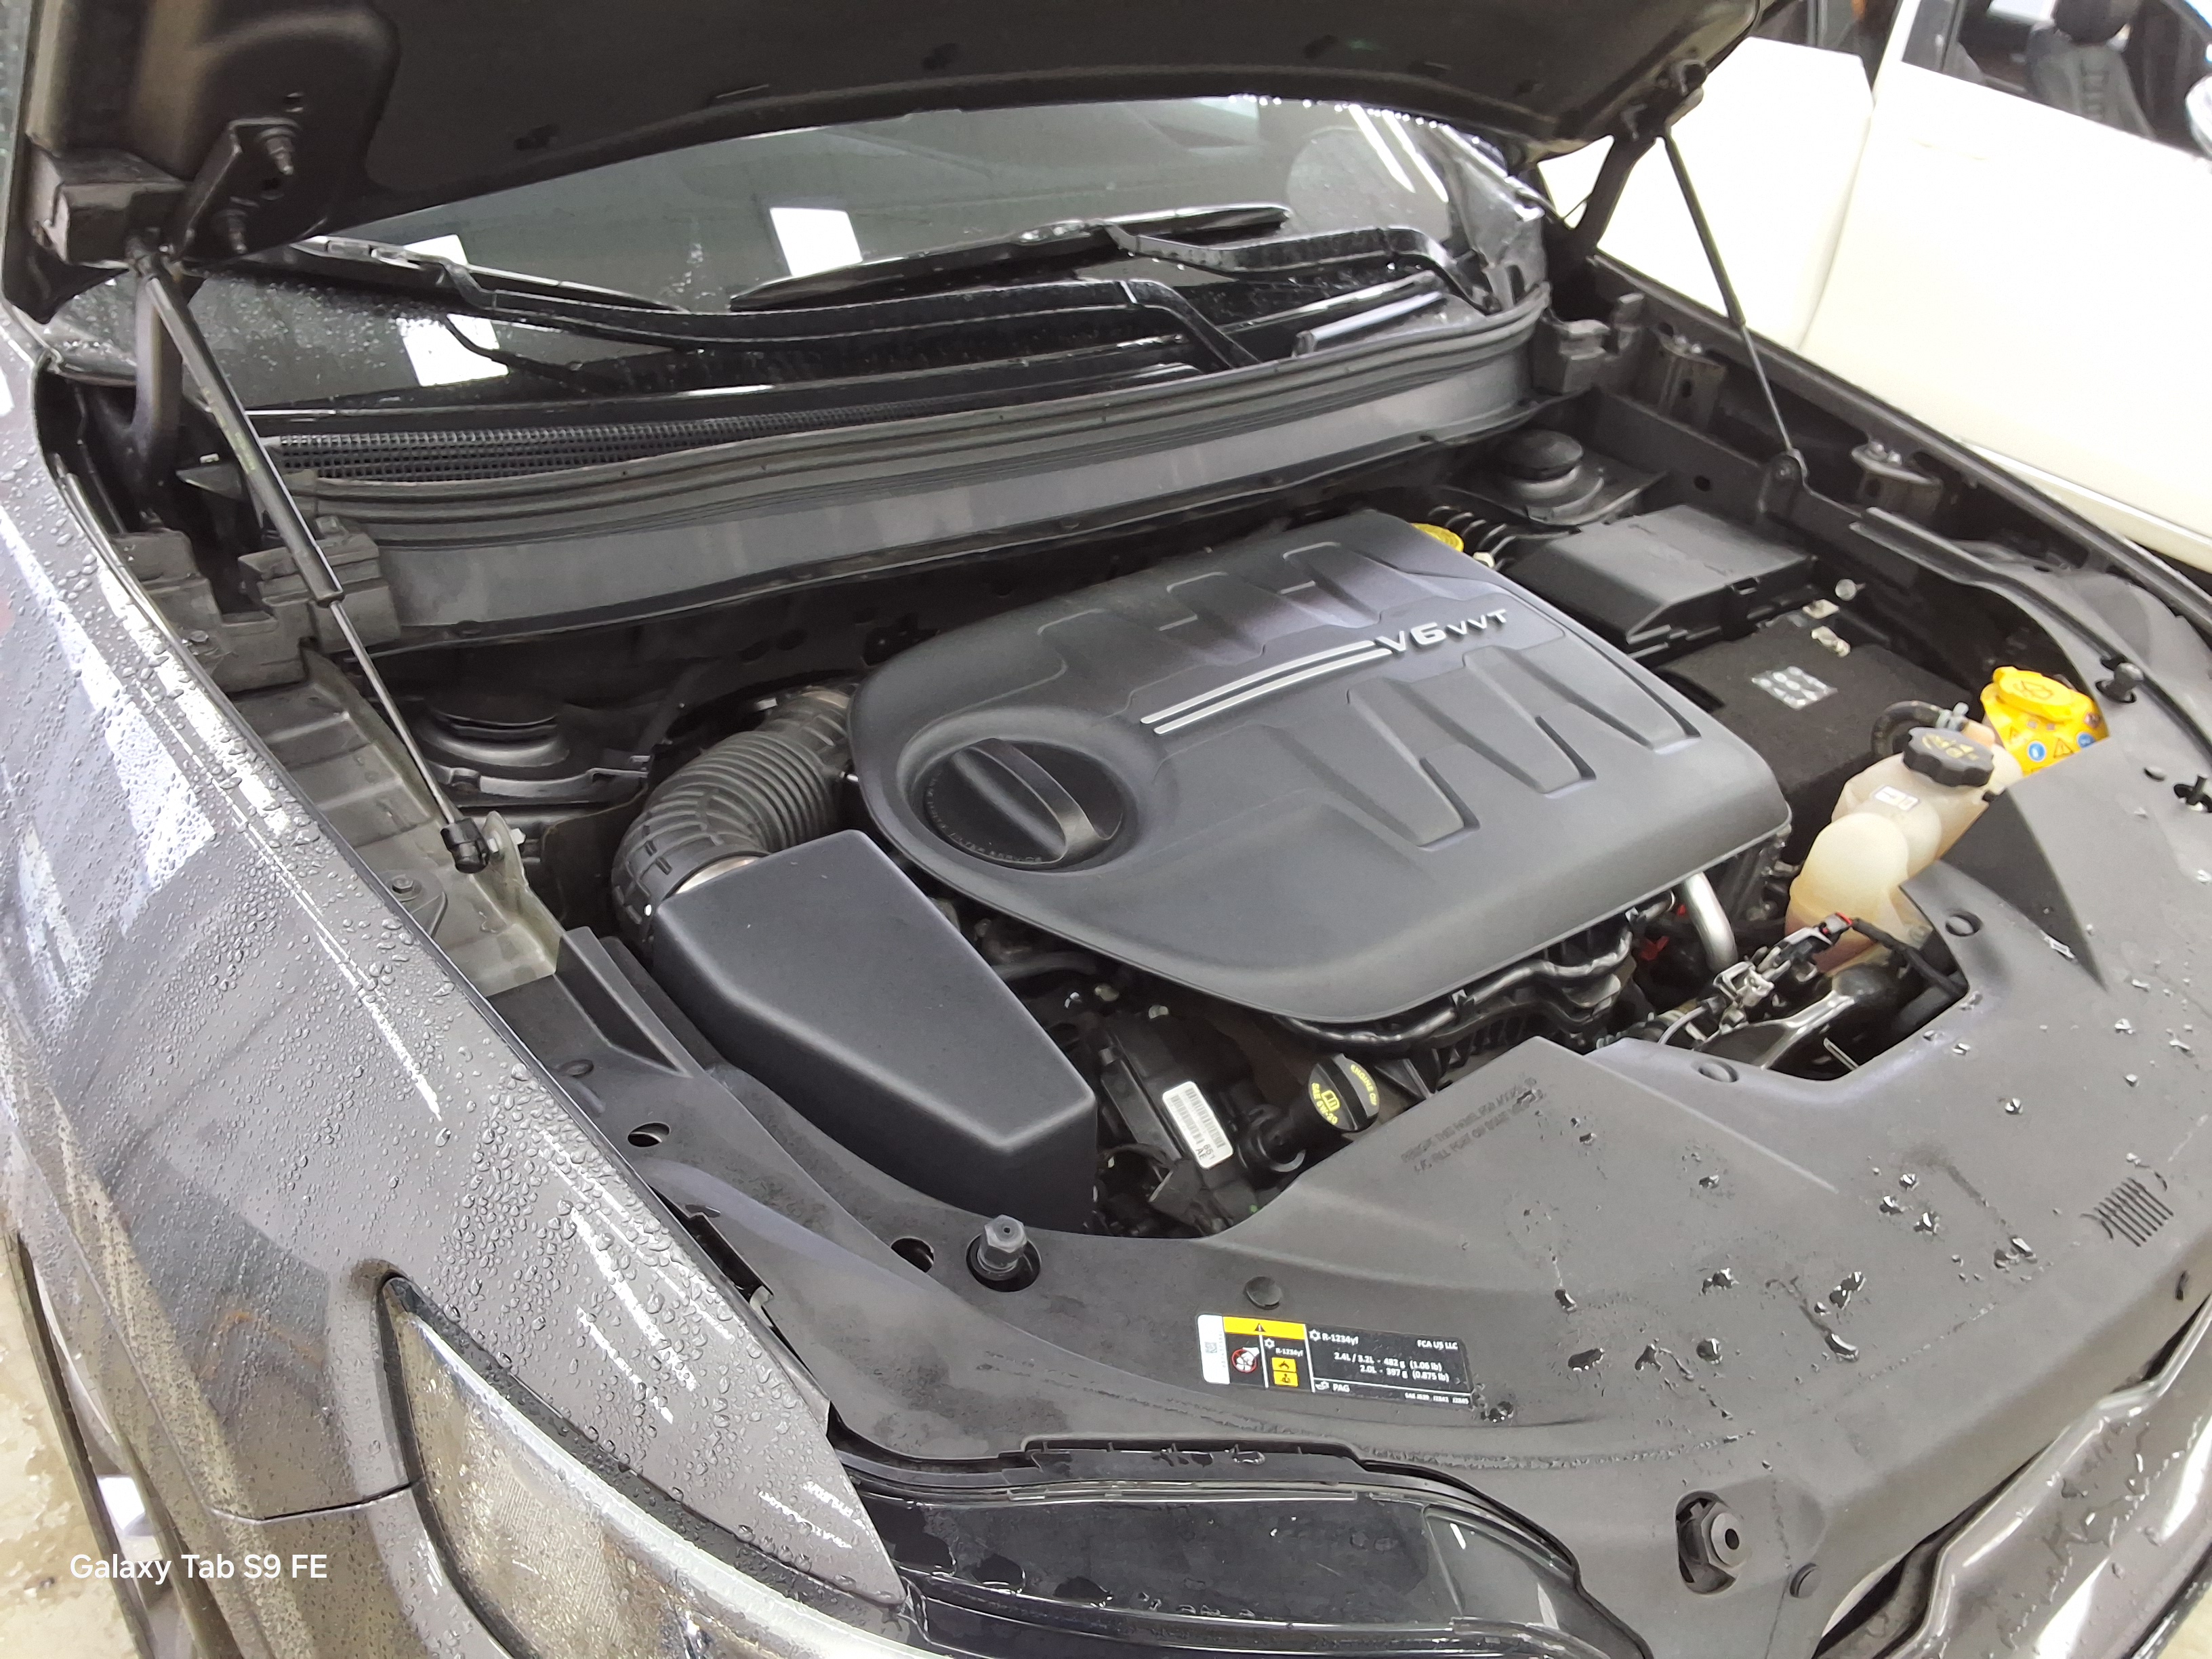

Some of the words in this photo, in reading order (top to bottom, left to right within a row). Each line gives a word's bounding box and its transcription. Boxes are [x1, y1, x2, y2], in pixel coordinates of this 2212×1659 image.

[1374, 622, 1446, 651] V6
[1446, 609, 1507, 635] VVT
[1312, 1082, 1322, 1100] SAE
[1316, 1100, 1338, 1124] 5W-20
[1322, 1332, 1359, 1346] R-1234yf
[1417, 1339, 1432, 1348] FCA
[1433, 1340, 1444, 1349] US
[1445, 1342, 1458, 1350] LLC
[1275, 1347, 1303, 1357] R-1234yf
[1334, 1352, 1351, 1361] 2.4L
[1357, 1354, 1374, 1364] 3.2L
[1431, 1361, 1442, 1372] lb)
[1359, 1364, 1377, 1374] 2.0L
[1386, 1368, 1400, 1376] 397
[1437, 1372, 1450, 1383] lb)
[1332, 1383, 1350, 1393] PAG
